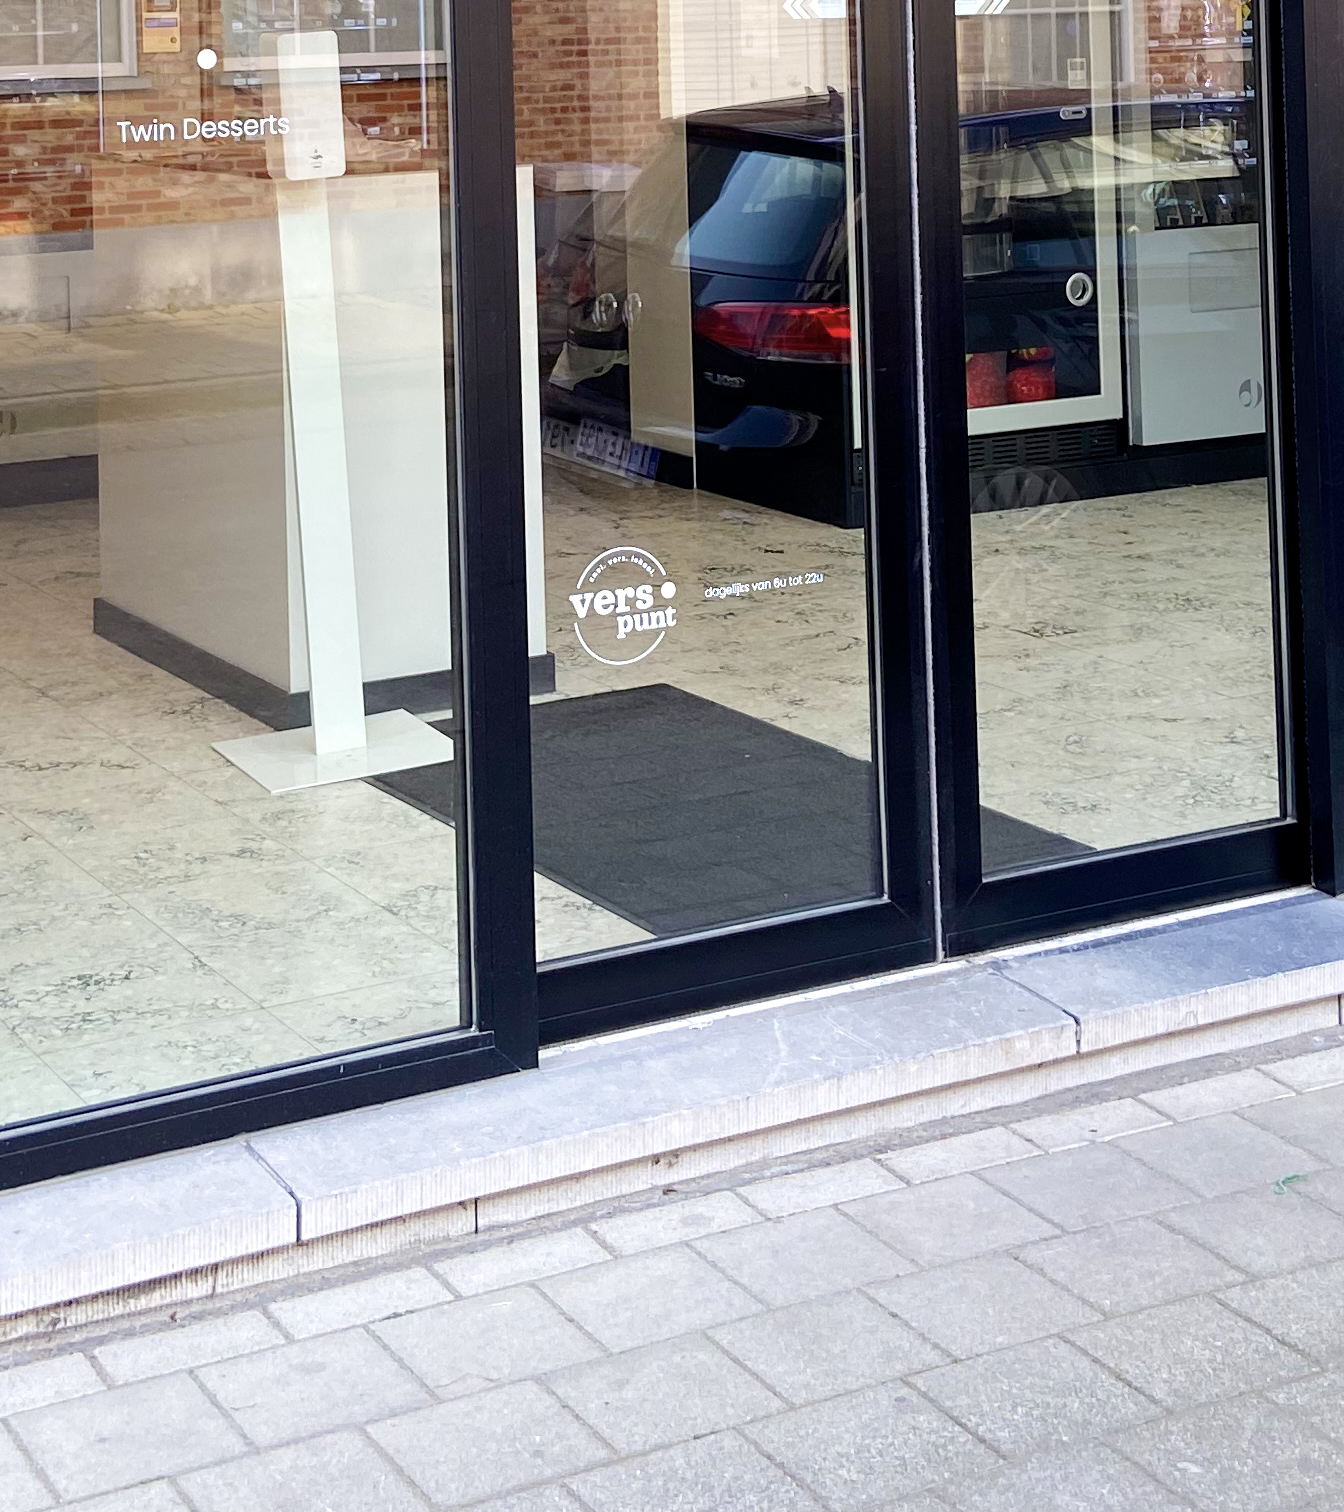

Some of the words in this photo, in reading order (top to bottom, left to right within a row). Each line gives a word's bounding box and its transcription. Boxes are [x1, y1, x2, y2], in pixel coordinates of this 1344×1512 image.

[117, 117, 175, 144] Twin
[183, 114, 291, 140] Desserts
[568, 584, 654, 619] vers
[704, 582, 750, 599] dagelijks
[752, 580, 772, 591] van
[788, 575, 803, 586] tot
[804, 572, 824, 584] 22u
[616, 605, 677, 639] punt
